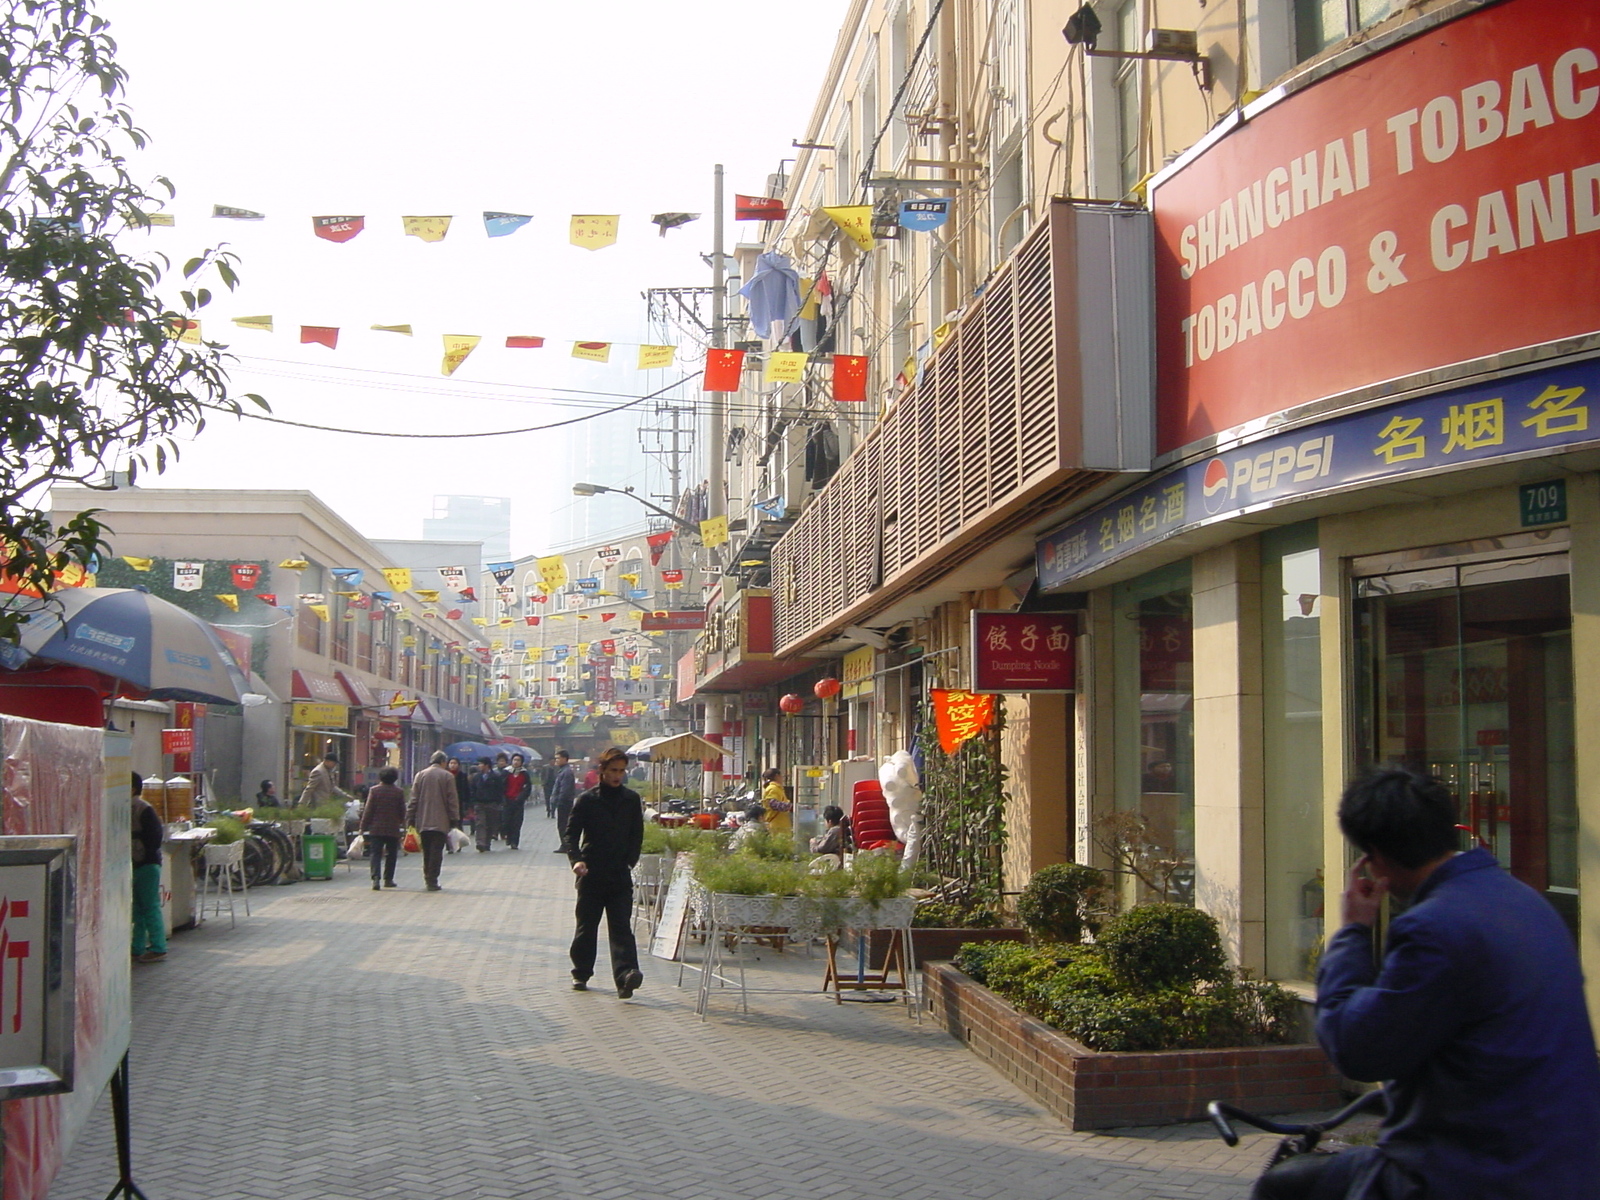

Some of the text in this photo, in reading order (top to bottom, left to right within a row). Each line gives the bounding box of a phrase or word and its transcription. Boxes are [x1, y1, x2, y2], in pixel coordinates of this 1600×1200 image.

[1179, 47, 1600, 280] SHANGHAI TOBAC
[1181, 162, 1600, 369] TOBACCO & CAND
[1373, 385, 1588, 464] 名烟名
[1230, 435, 1334, 499] PEPSI
[1527, 485, 1558, 511] 709
[1055, 528, 1089, 574] 百事可乐
[1098, 482, 1186, 554] 名烟名酒
[992, 659, 1061, 672] Dumpling Noodle
